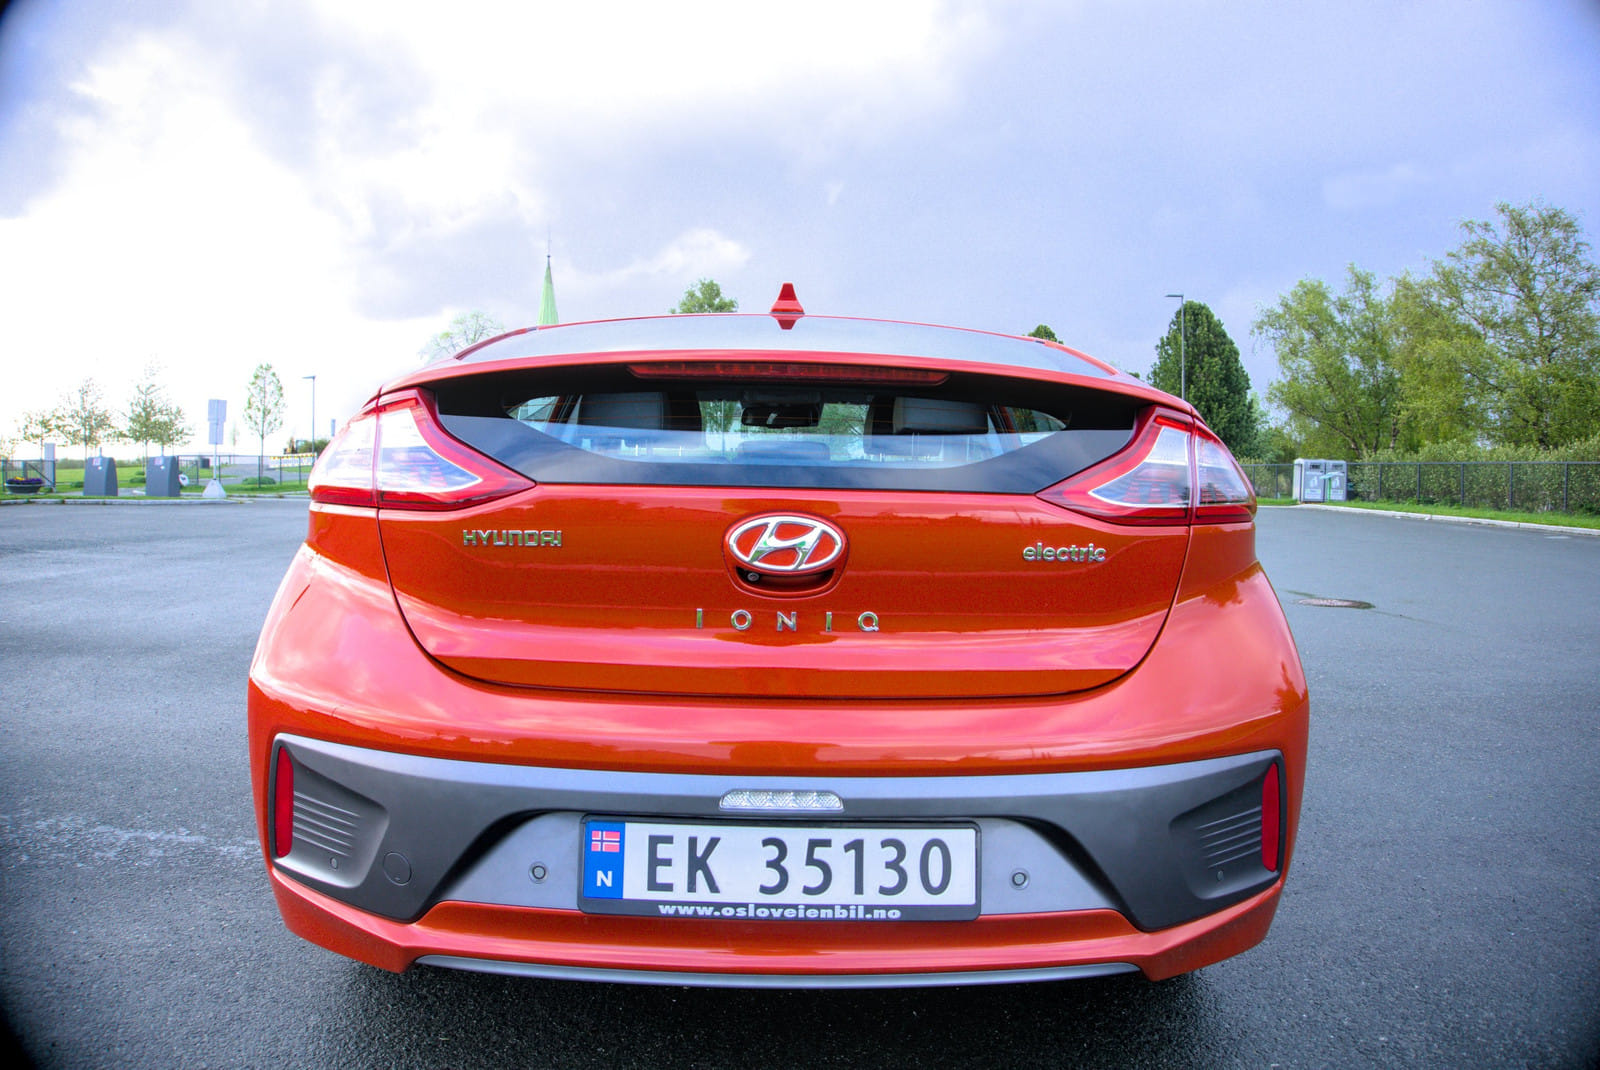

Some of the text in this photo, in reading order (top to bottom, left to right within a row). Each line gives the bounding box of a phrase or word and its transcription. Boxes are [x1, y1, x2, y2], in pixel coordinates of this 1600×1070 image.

[462, 529, 563, 547] HYUNDAI
[1022, 541, 1107, 562] electric
[646, 834, 953, 896] EK 35130
[596, 870, 613, 887] N
[658, 903, 902, 921] www.osloveienbil.no
